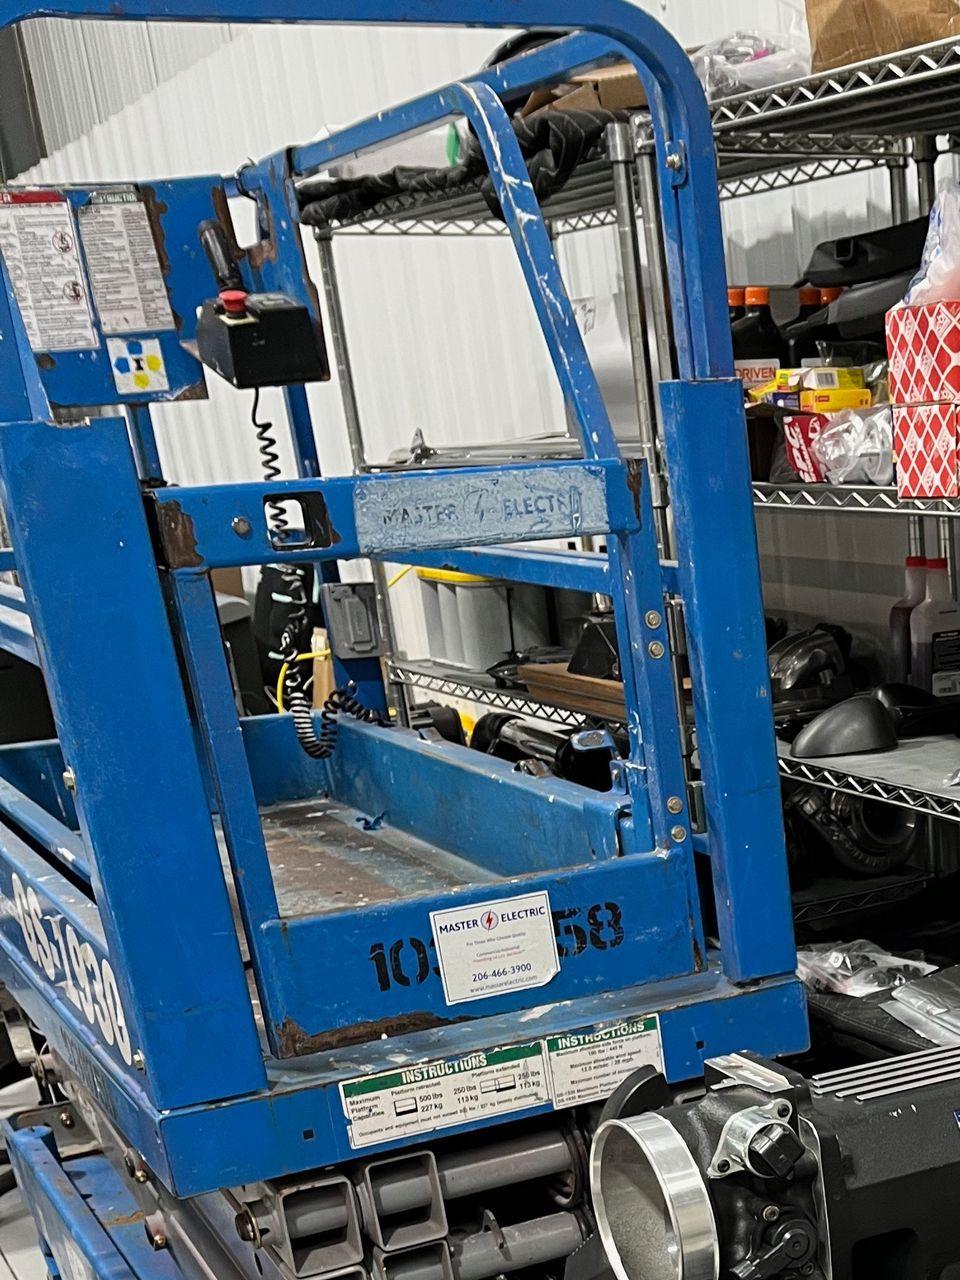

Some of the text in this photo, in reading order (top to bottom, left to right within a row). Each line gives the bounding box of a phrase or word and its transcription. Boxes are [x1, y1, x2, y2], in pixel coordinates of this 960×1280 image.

[439, 906, 546, 934] MASTER ELECTRIC
[472, 963, 532, 982] 206-466-3900
[470, 975, 538, 993] www.masterelectric.com
[557, 1021, 645, 1049] INSTRUCTIONS
[401, 1054, 488, 1085] INSTRUCTIONS
[530, 1070, 541, 1078] lbs
[453, 1084, 477, 1095] 250 lbs
[530, 1079, 541, 1088] kg
[349, 1094, 381, 1107] Maximum
[418, 1091, 443, 1102] 500 lbs
[457, 1094, 479, 1104] 113 kg
[420, 1101, 443, 1113] 227 kg
